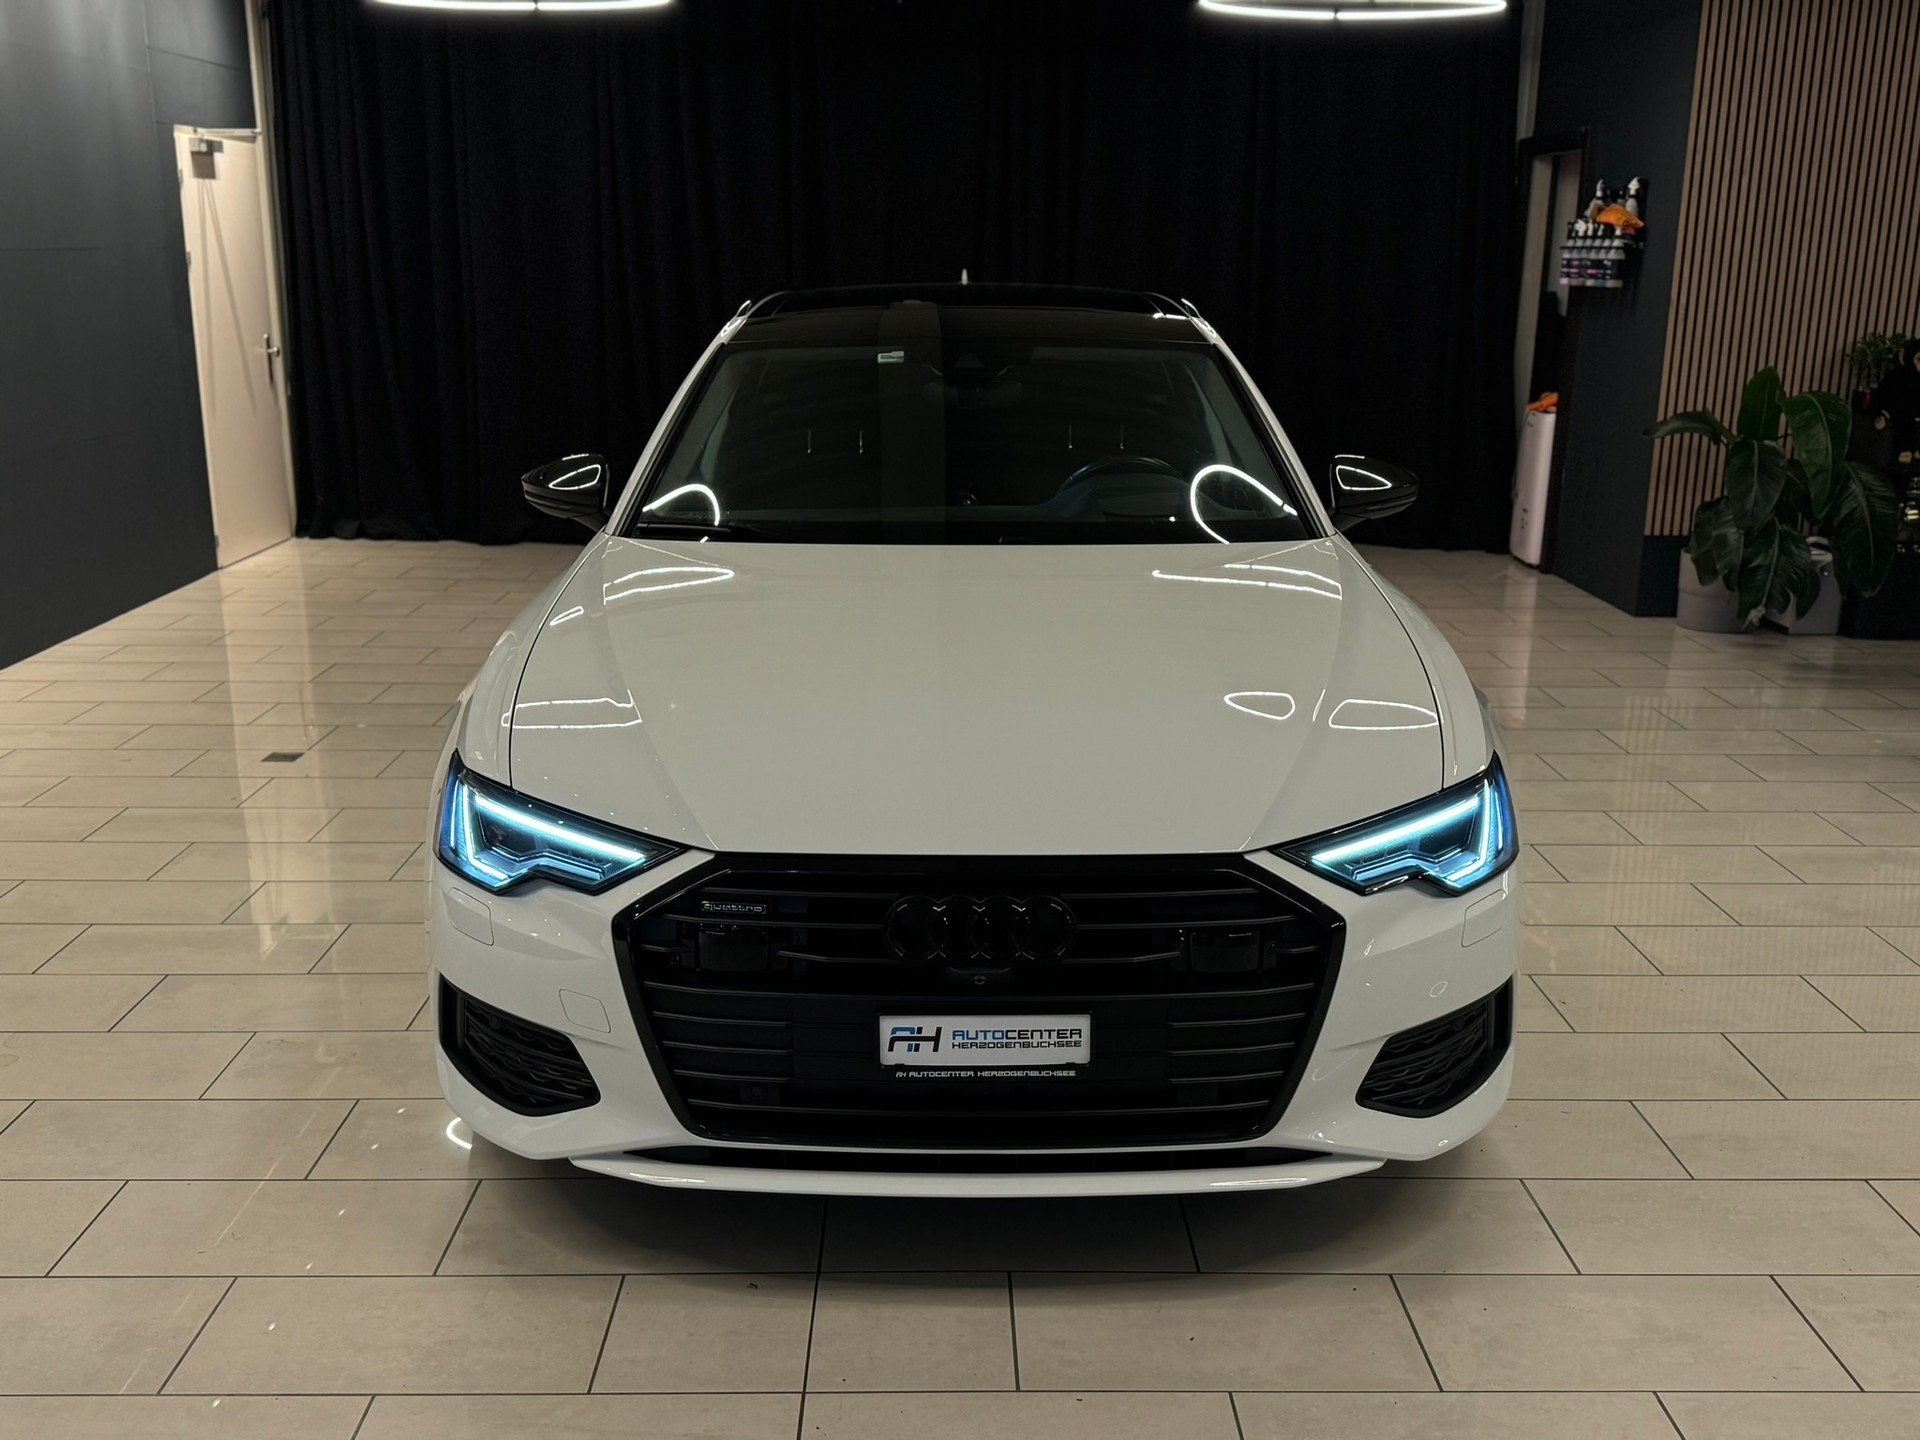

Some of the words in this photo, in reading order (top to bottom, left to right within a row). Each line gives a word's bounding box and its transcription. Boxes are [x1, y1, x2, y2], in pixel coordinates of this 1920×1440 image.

[952, 1028, 1083, 1041] AUTOCENTER
[952, 1040, 1083, 1049] HERZOGENBUCHSEE
[908, 1070, 974, 1078] AUTOCENTER
[977, 1070, 1077, 1078] HERZOGENBUCHSEE
